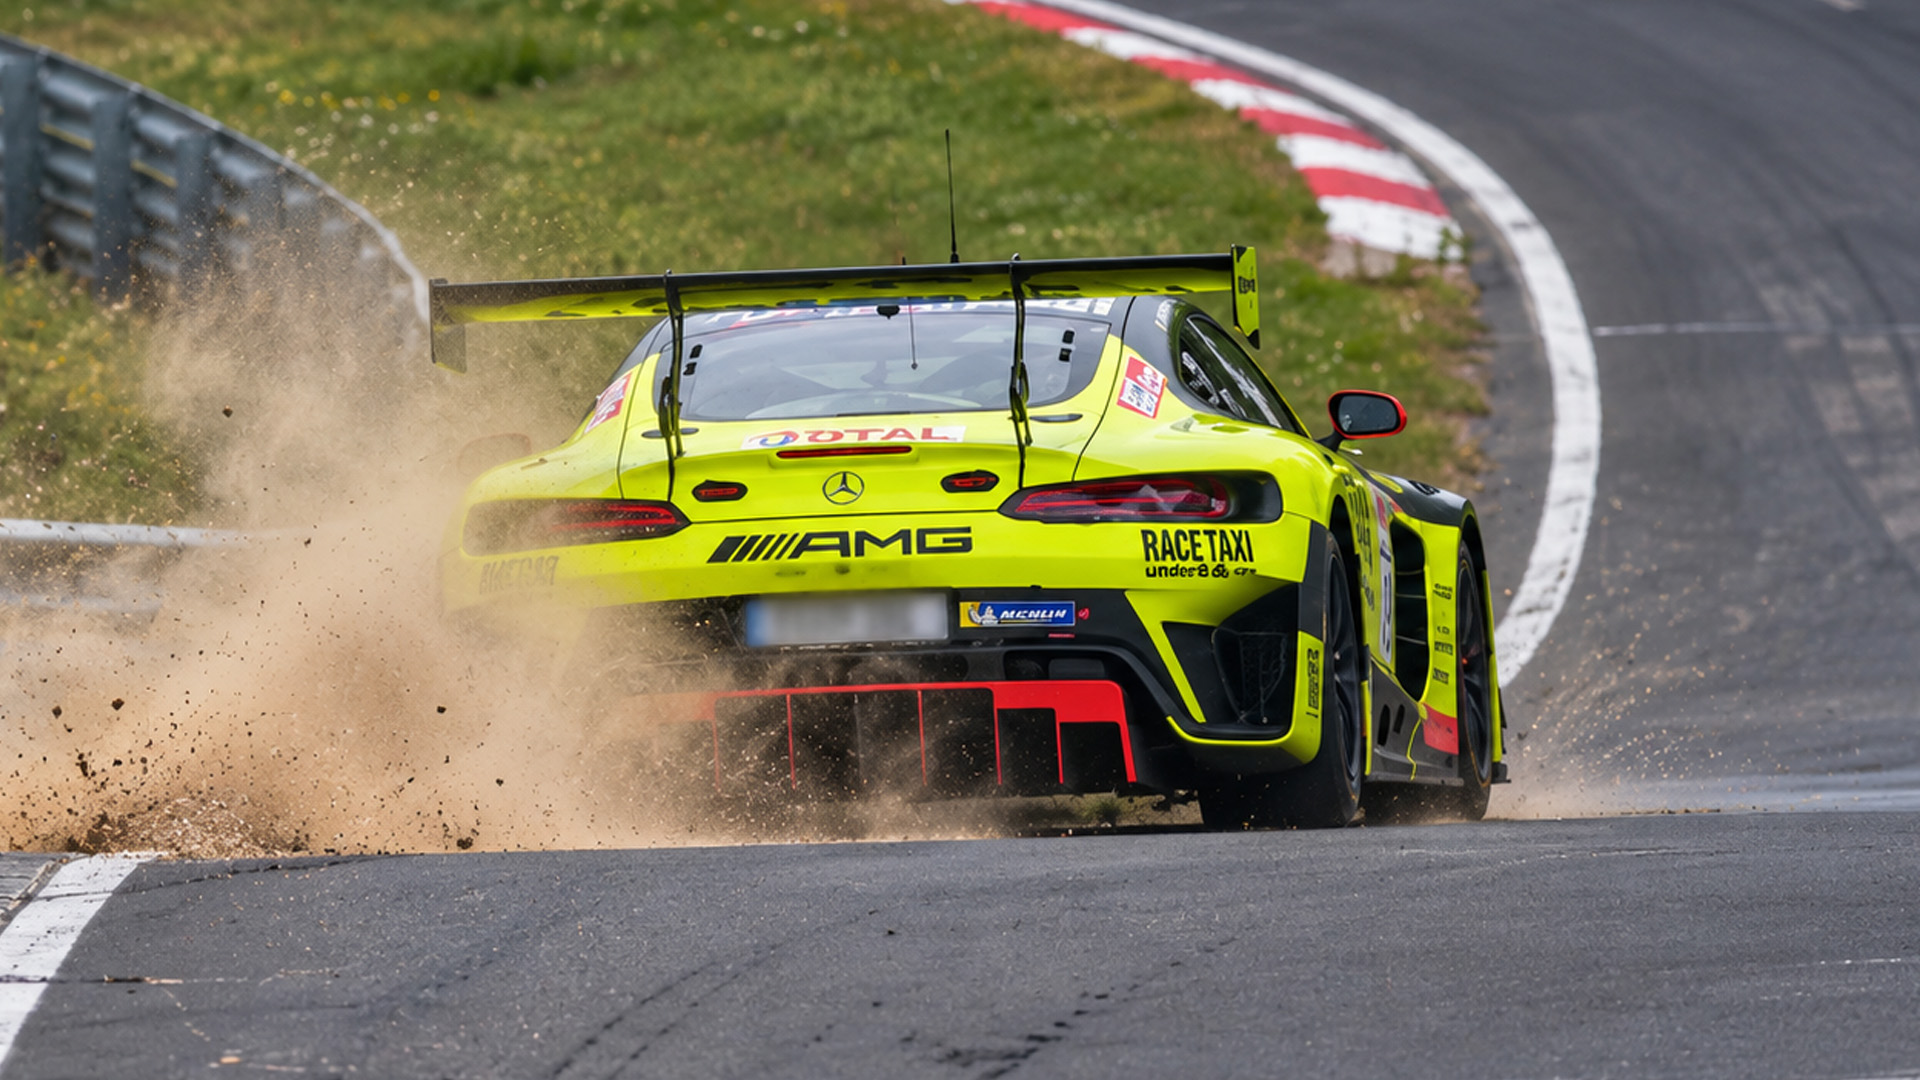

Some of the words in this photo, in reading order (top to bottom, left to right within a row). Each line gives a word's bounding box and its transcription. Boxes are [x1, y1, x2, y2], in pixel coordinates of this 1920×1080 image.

[787, 526, 973, 560] AMG
[1140, 528, 1204, 562] RACE
[1203, 528, 1254, 562] TAXI
